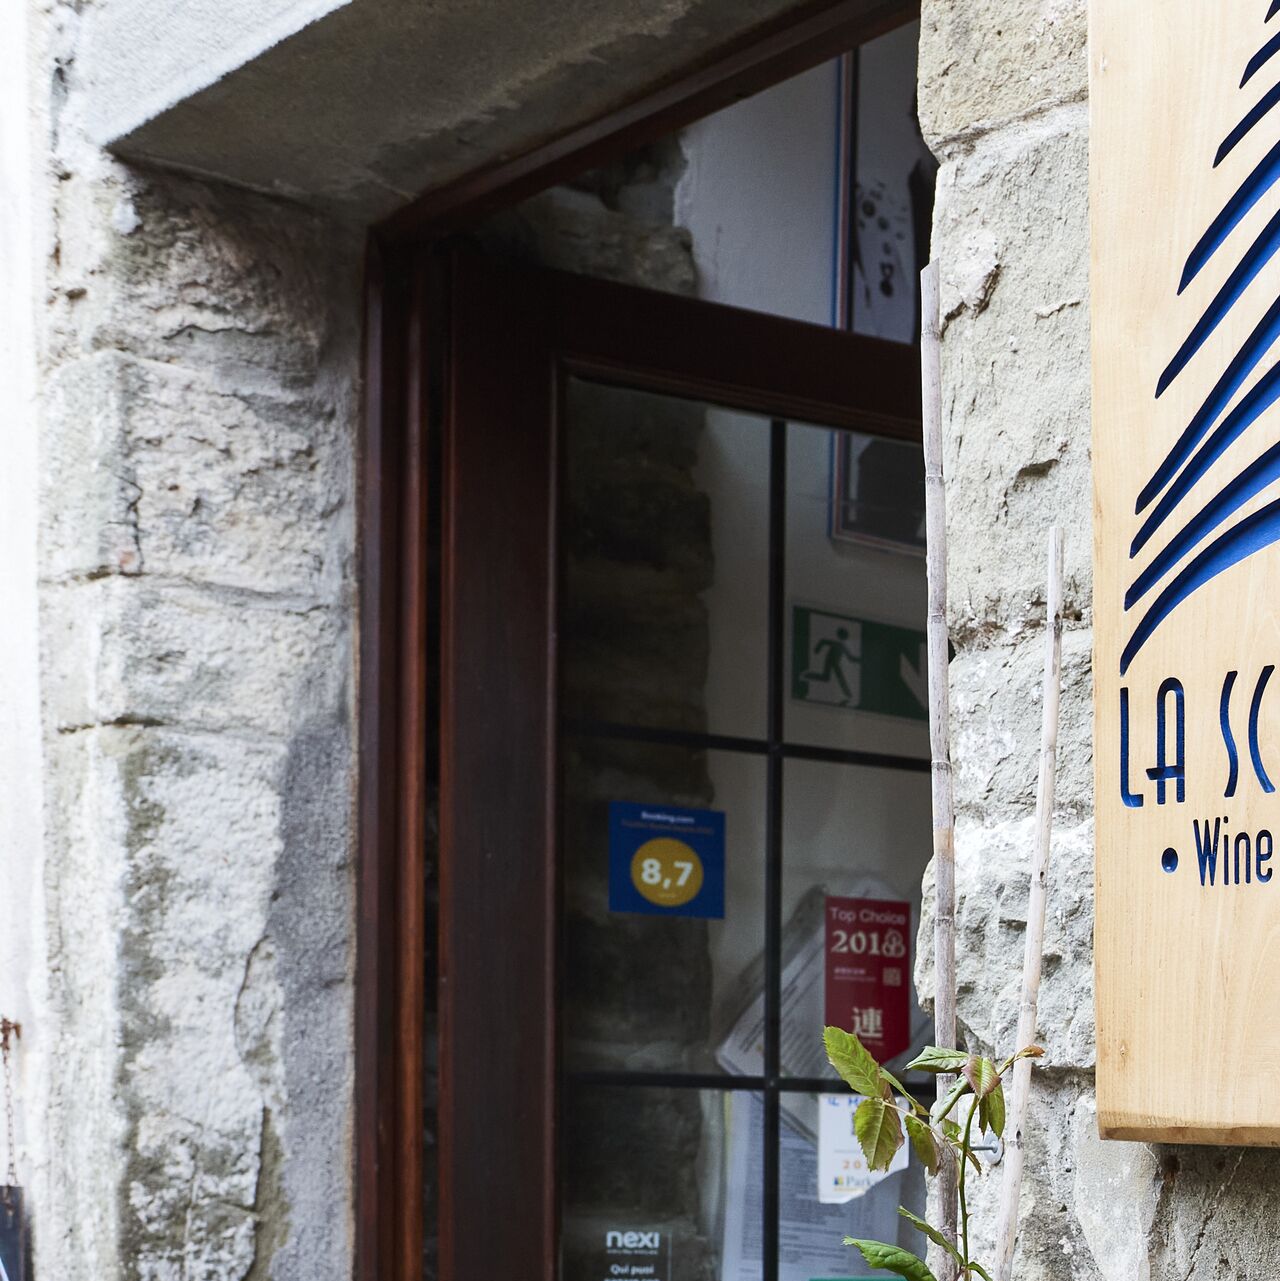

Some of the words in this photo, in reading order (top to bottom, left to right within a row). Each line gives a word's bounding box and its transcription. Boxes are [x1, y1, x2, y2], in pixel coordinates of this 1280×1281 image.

[1120, 677, 1185, 808] LA
[1193, 816, 1273, 886] Wine
[641, 858, 693, 890] 8,7
[830, 906, 856, 923] Top
[859, 908, 906, 925] Choice
[606, 1231, 660, 1248] nexi
[610, 1264, 630, 1275] Qui
